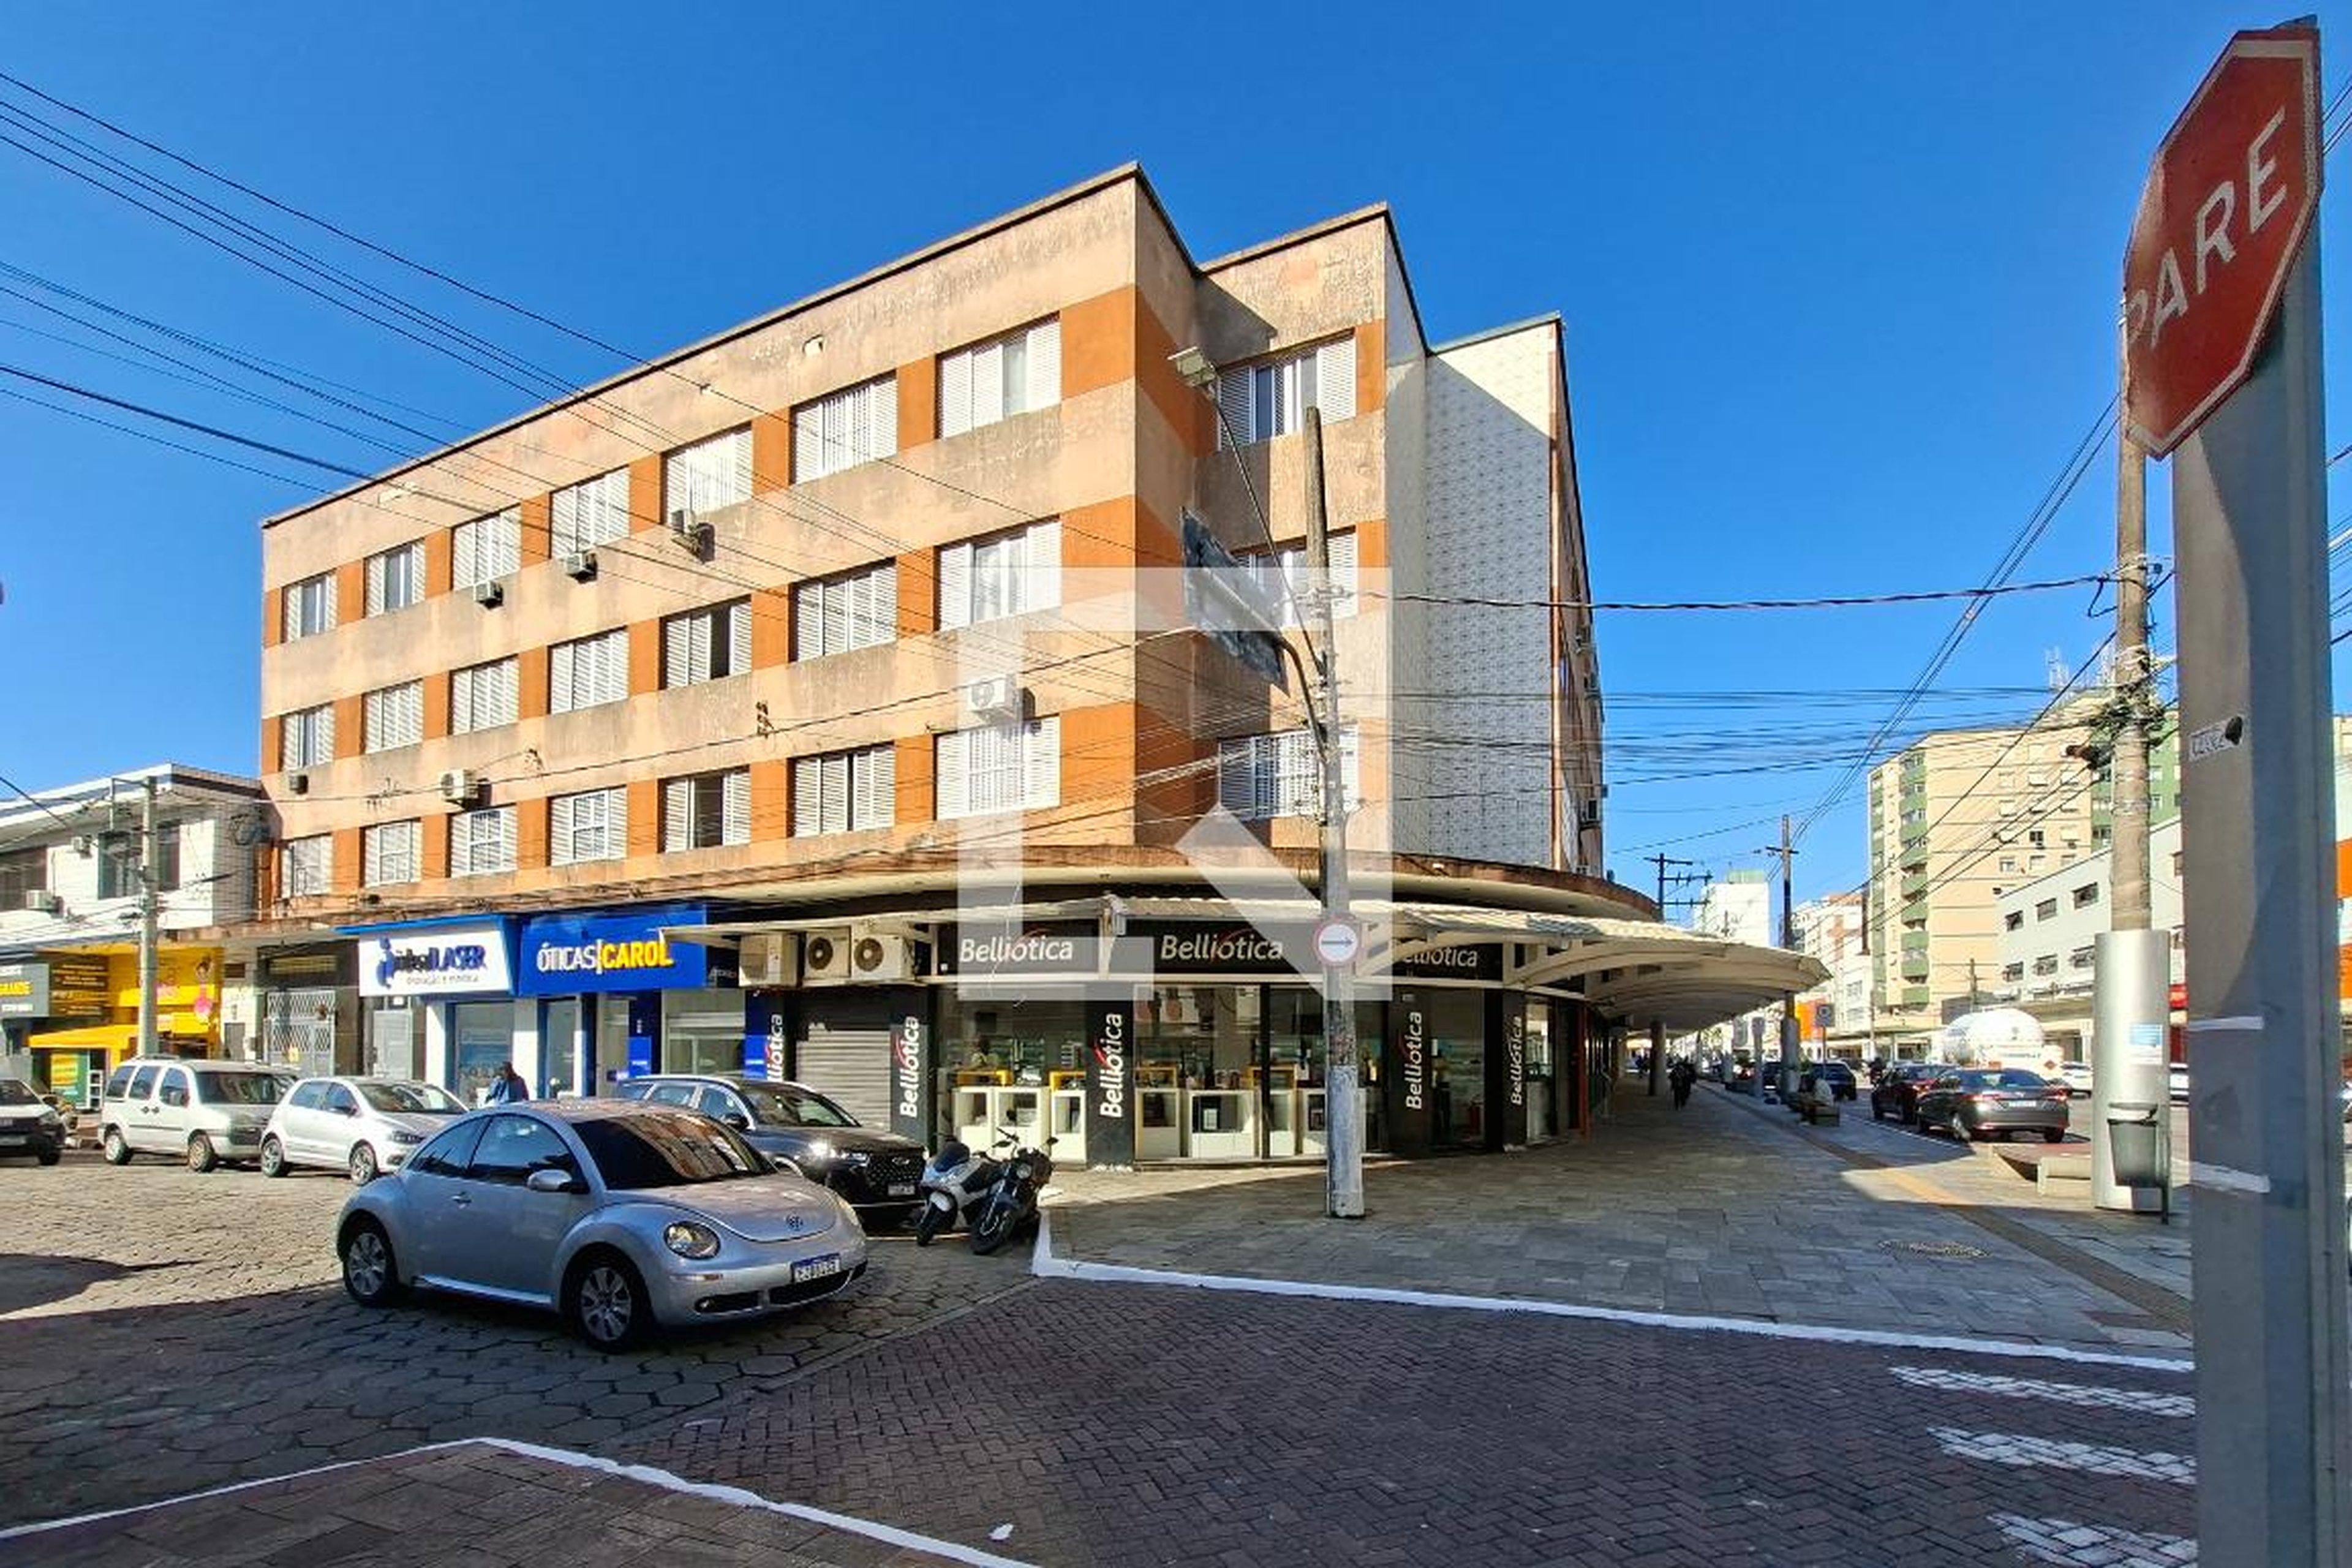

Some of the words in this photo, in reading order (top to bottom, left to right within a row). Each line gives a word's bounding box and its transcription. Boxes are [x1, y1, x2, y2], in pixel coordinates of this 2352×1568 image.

[2125, 105, 2287, 349] PARE
[537, 941, 596, 972] ÓTICAS
[602, 940, 673, 968] CAROL
